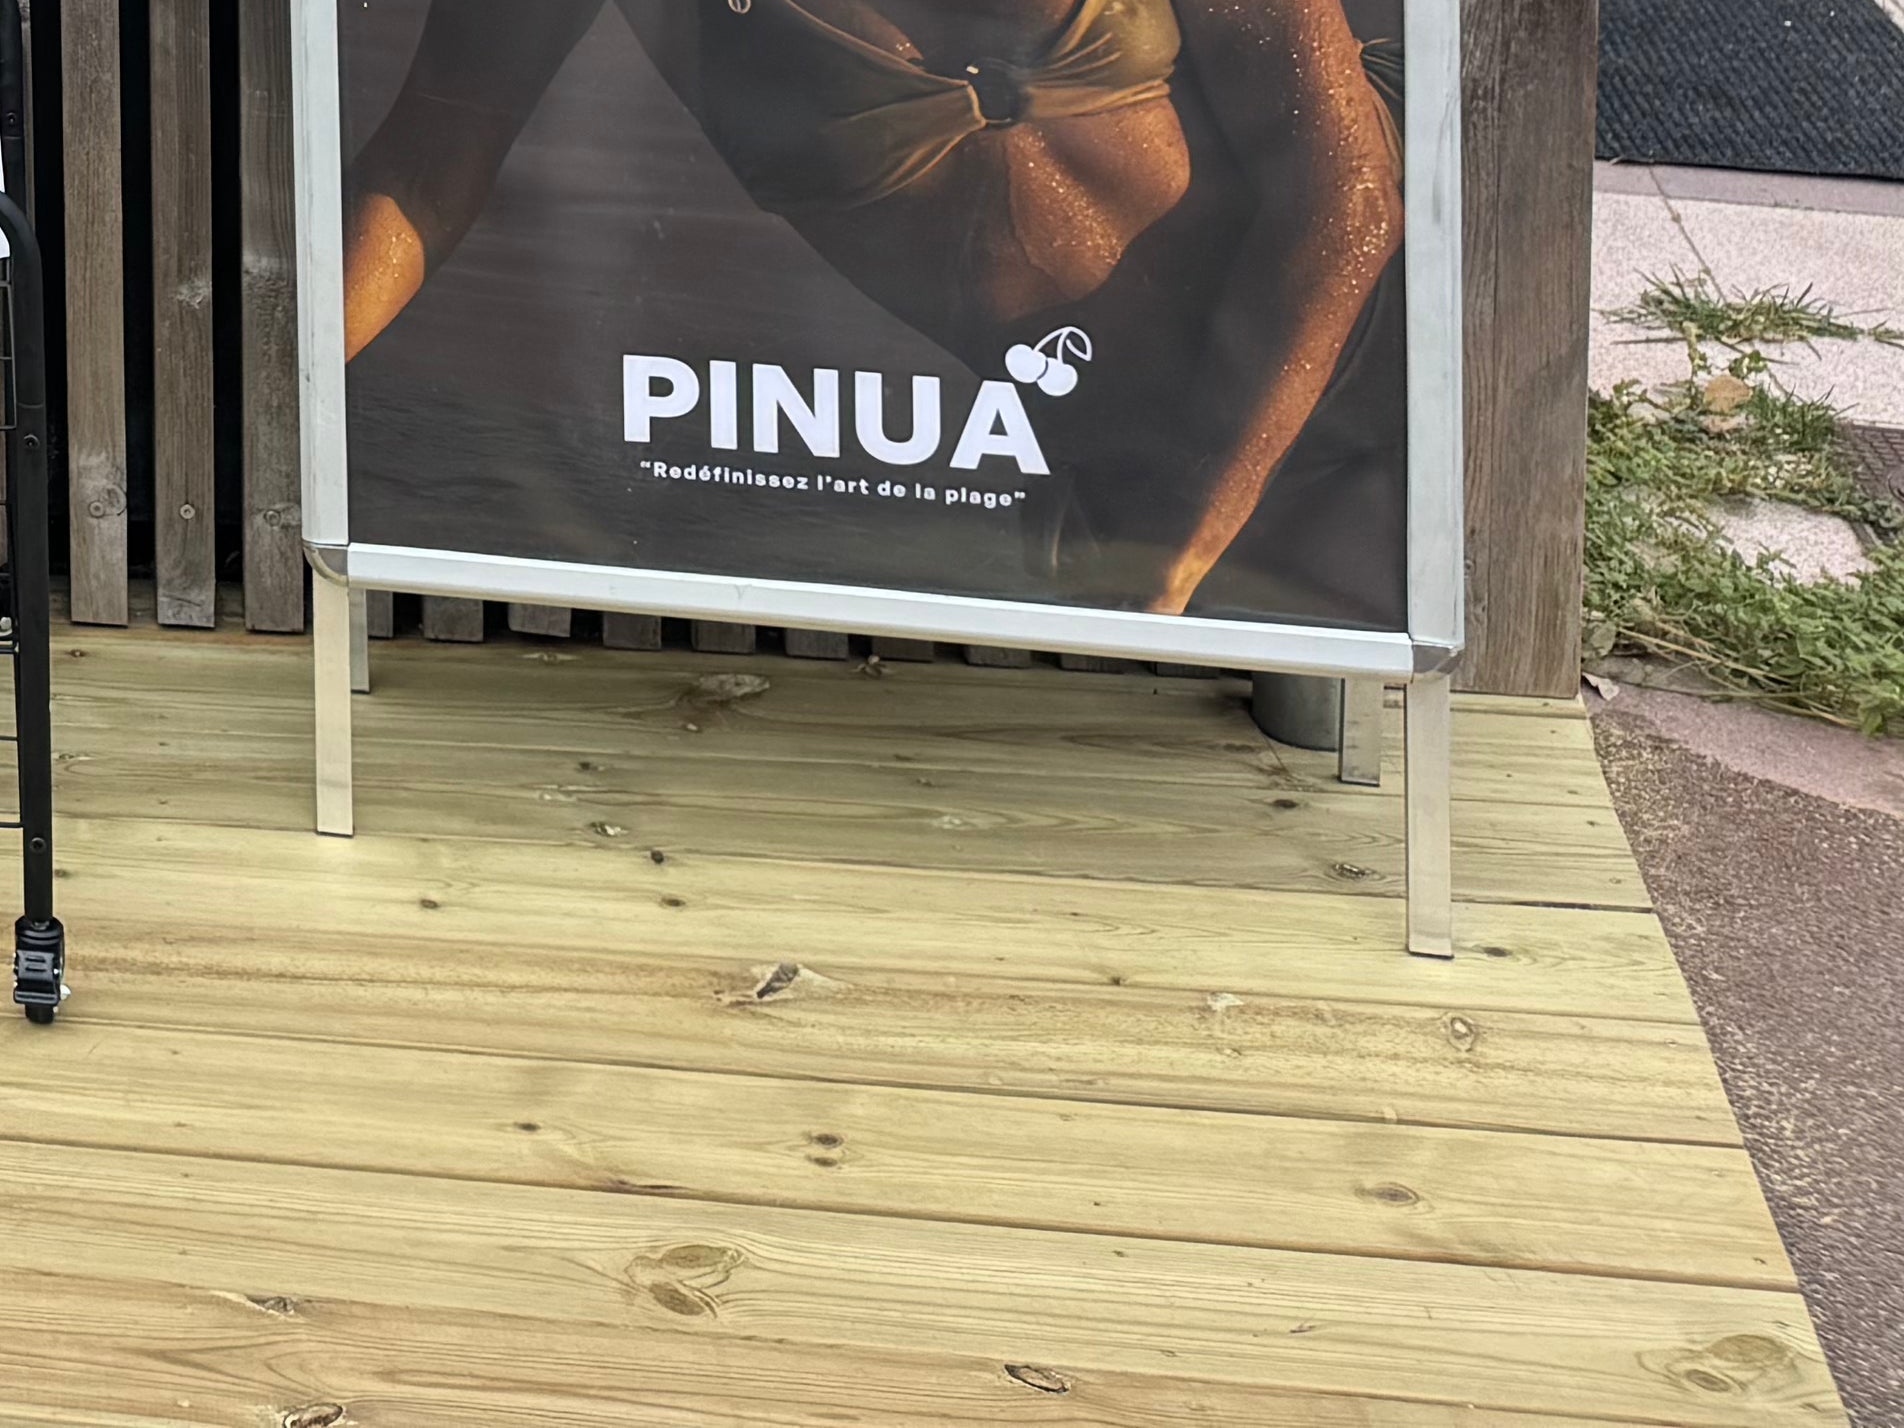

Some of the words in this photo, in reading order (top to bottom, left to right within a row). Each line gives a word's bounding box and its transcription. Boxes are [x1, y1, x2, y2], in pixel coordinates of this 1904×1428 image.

[622, 353, 1052, 476] PINUA
[876, 480, 907, 498] de
[914, 482, 936, 501] la
